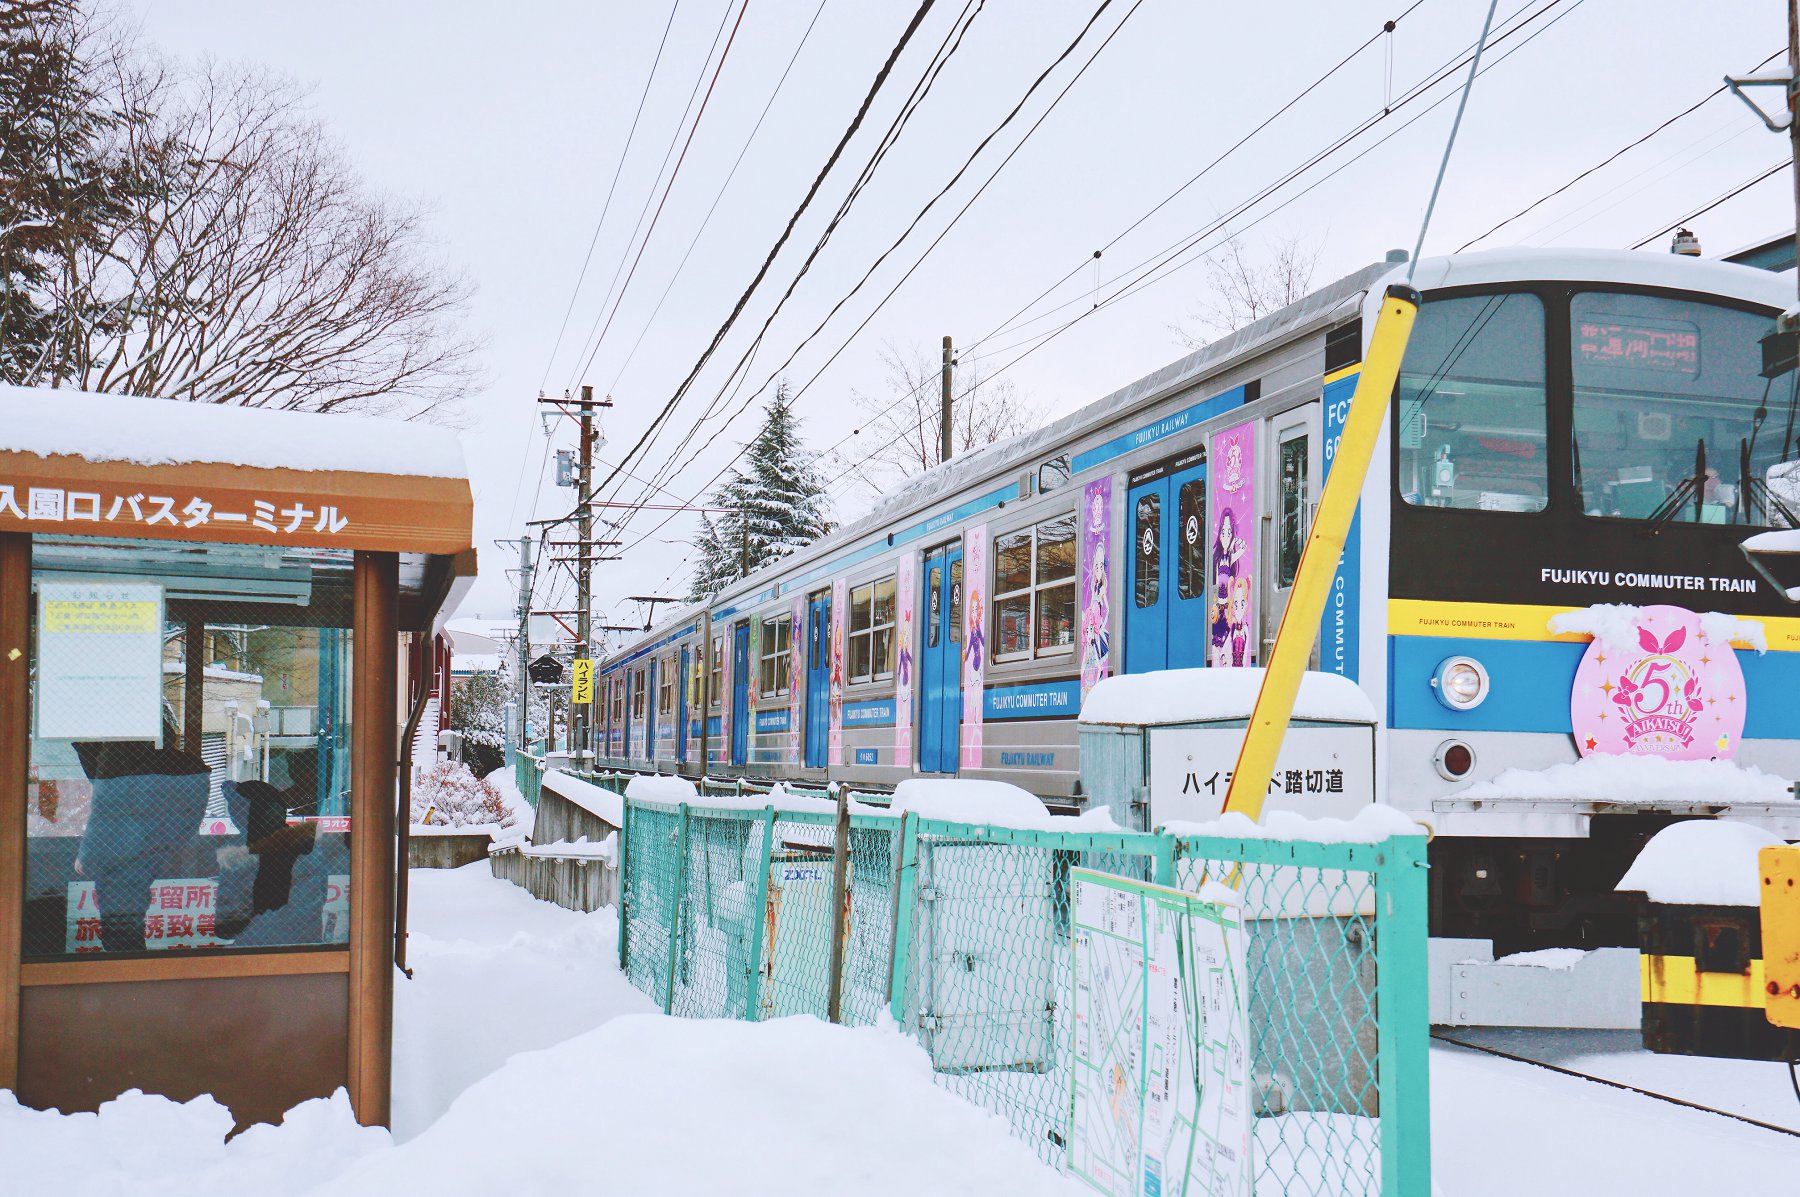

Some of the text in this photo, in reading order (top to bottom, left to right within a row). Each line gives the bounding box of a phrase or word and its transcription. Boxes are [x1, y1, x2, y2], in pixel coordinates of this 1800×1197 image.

[1135, 413, 1189, 445] FUJIKYU RAILWAY
[0, 485, 349, 533] 入園口バスターミナル
[1541, 568, 1757, 593] FUJIKYU COMMUTER TRAIN
[1335, 576, 1344, 675] COMMUT
[1419, 618, 1515, 629] FUJIKYU COMMUTER TRAIN
[577, 661, 589, 700] ハイランド
[993, 691, 1068, 710] FUJIKYU COMMUTER TRAIN
[1182, 769, 1344, 795] ハイド踏切道
